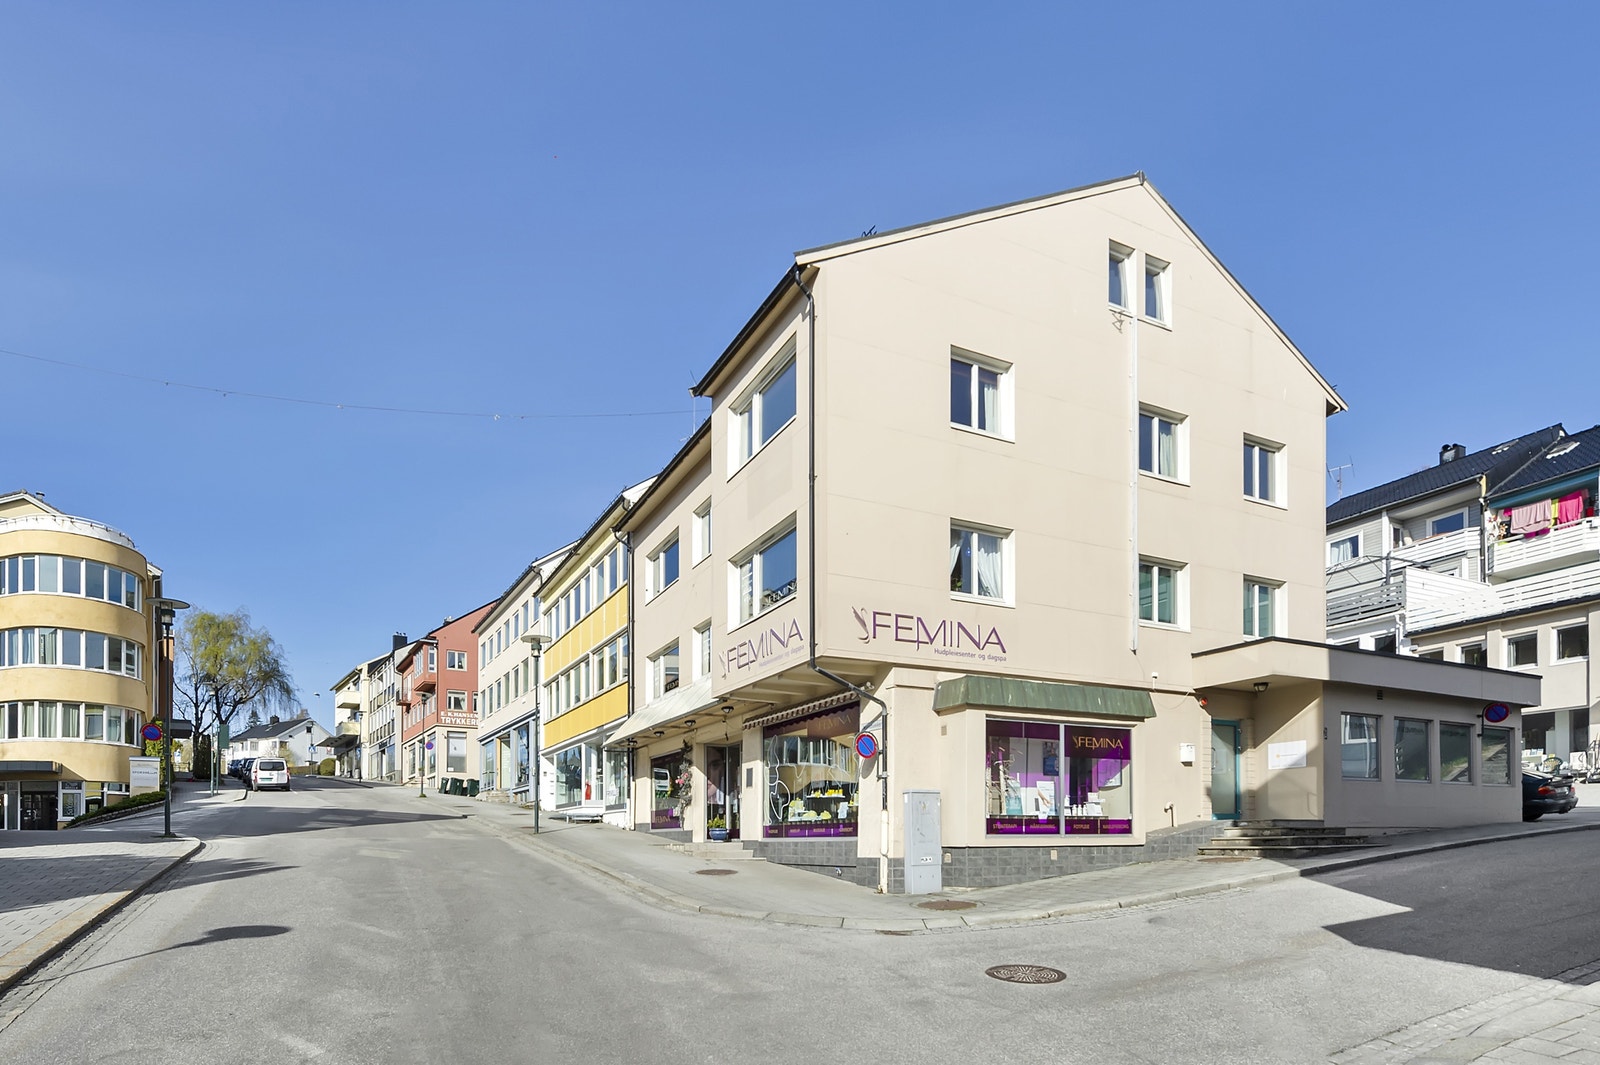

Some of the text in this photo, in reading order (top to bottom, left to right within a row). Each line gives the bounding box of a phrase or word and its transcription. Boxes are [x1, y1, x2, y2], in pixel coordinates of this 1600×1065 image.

[727, 617, 803, 672] FEMINA
[872, 611, 1006, 653] FEMINA
[987, 654, 1007, 663] dagspa
[1078, 736, 1123, 749] FEMINA
